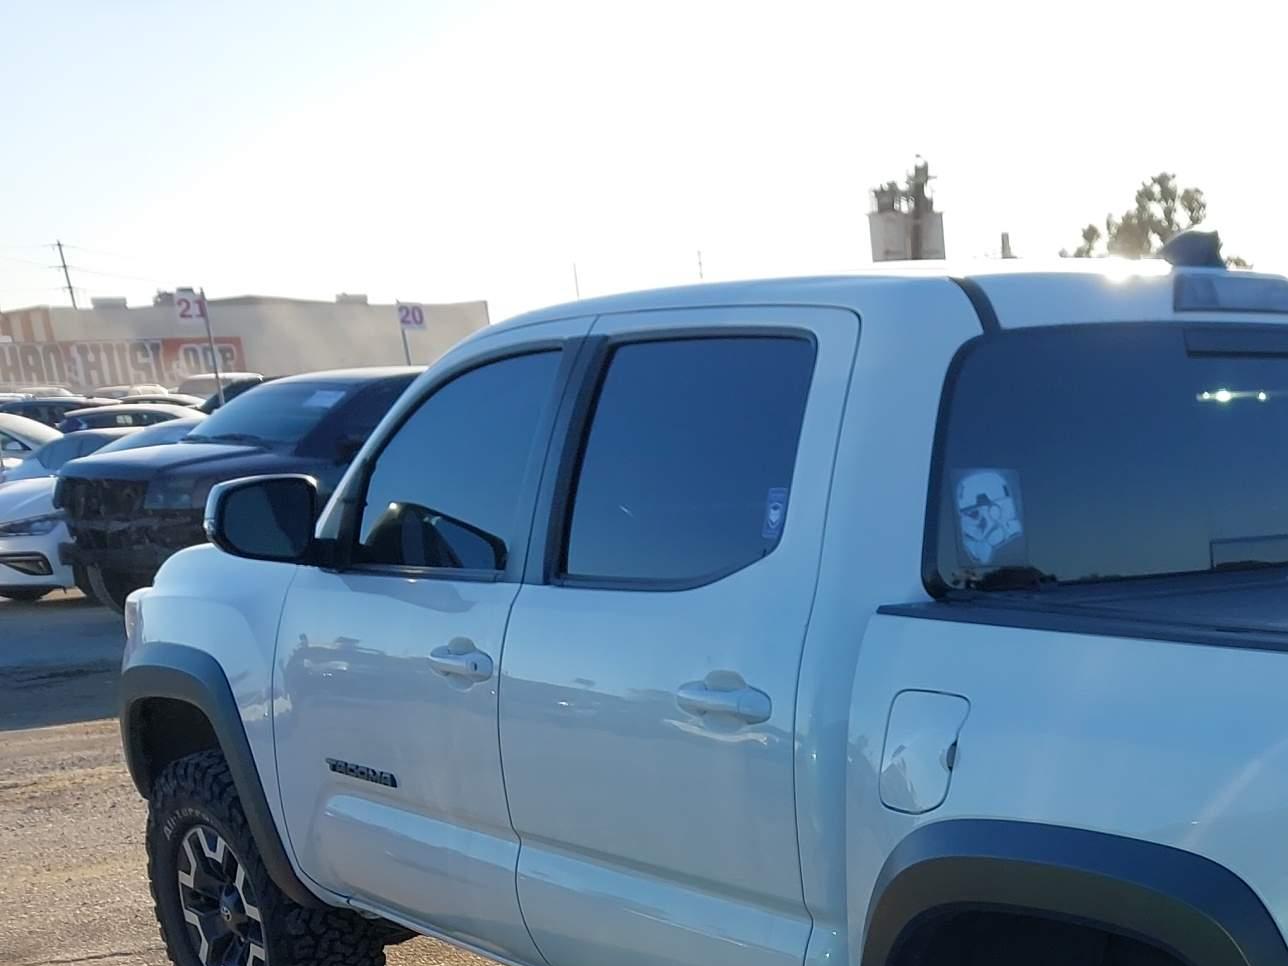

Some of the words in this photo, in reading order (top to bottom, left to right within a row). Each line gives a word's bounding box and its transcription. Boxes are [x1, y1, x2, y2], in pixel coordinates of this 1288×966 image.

[177, 298, 206, 318] 21
[398, 305, 424, 325] 20
[325, 758, 398, 788] TACOMA
